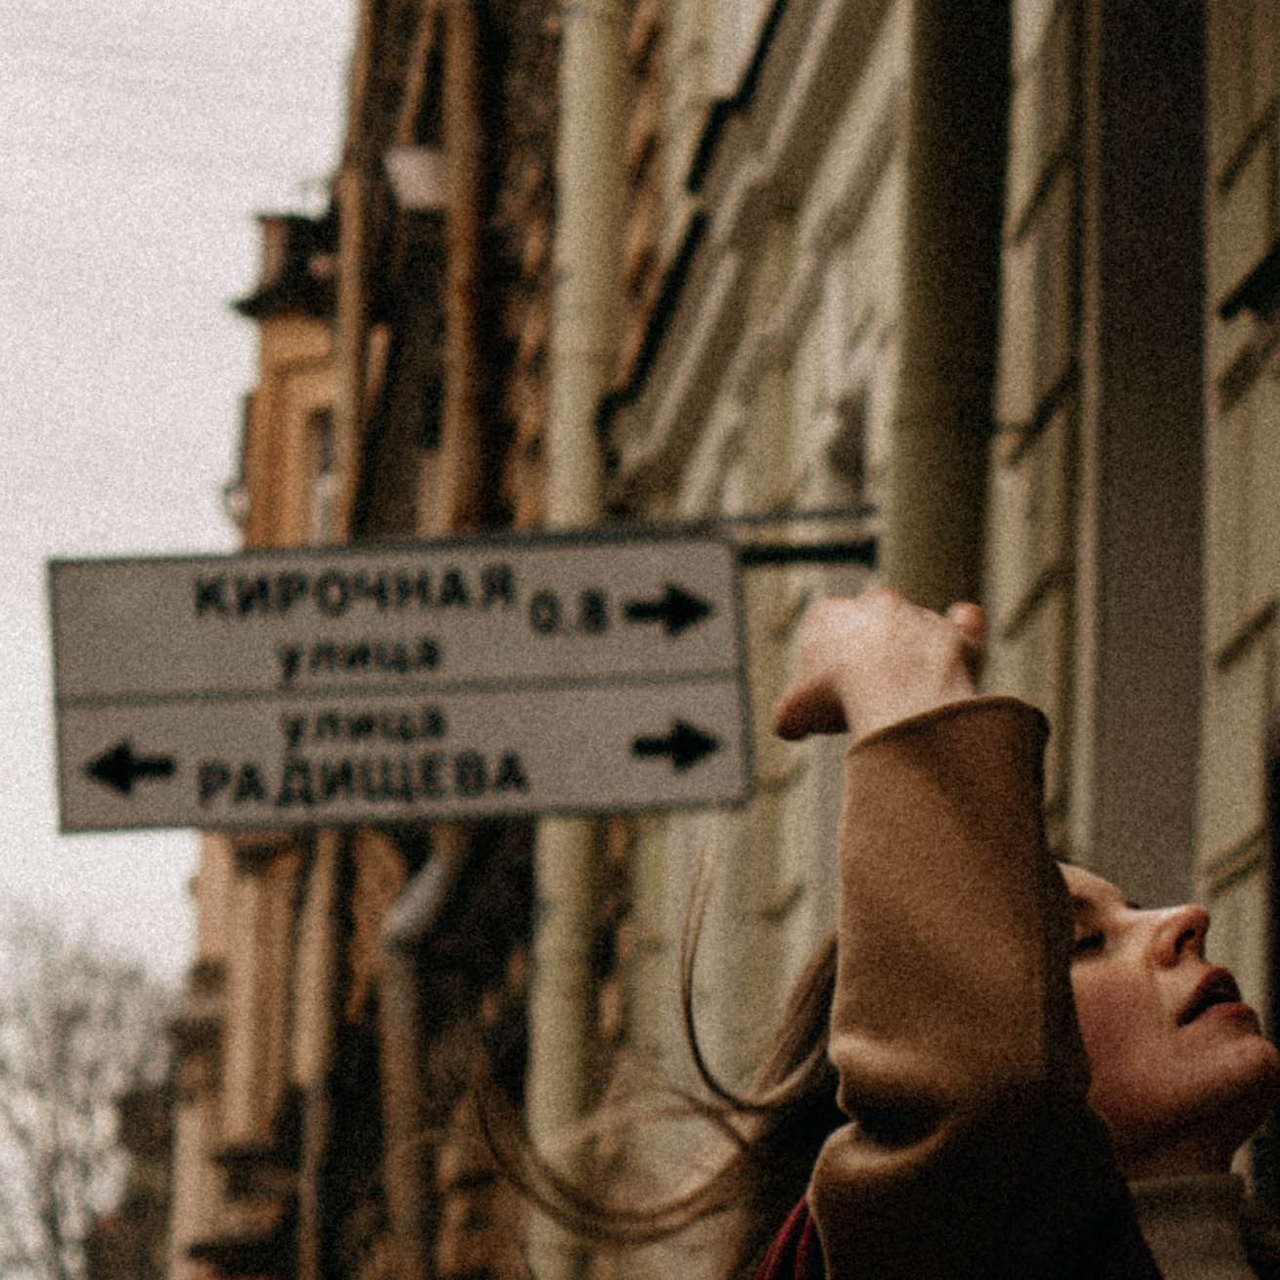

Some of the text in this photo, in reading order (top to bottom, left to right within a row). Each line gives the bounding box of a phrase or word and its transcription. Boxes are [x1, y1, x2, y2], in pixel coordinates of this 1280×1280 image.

[196, 564, 516, 619] КИРОЧНАЯ
[280, 638, 441, 685] улица
[281, 705, 446, 749] улица
[199, 750, 530, 808] РАДИЩЕВА
